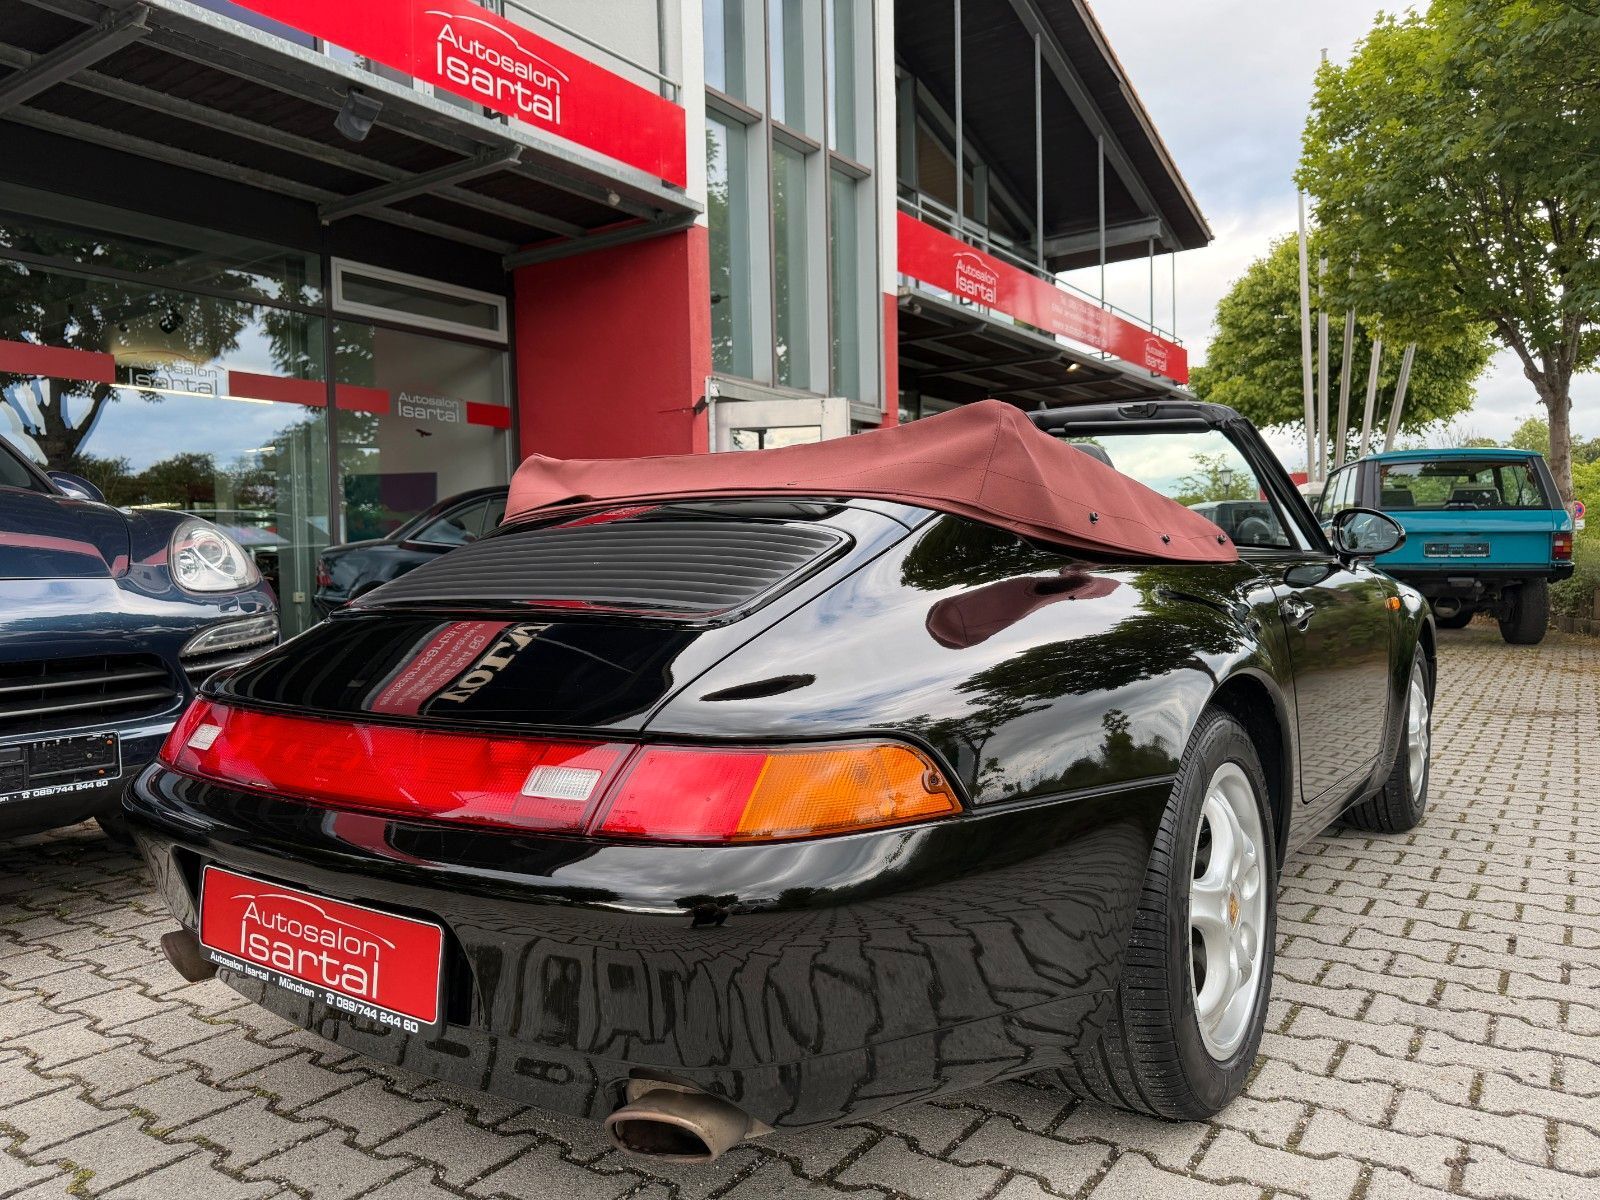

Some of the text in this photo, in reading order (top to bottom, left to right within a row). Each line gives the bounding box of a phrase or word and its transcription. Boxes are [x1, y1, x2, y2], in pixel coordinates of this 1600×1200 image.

[437, 23, 560, 94] Autosalon
[437, 42, 561, 125] Isartal
[955, 269, 996, 304] Isartal
[956, 259, 996, 286] Autosalon
[128, 368, 218, 395] Isartal
[398, 402, 460, 423] Isartal
[399, 392, 459, 408] Autosalon
[33, 780, 109, 797] 089/744 244 60
[242, 901, 380, 961] Autosalon
[240, 920, 379, 999] Isartal
[210, 950, 419, 1034] Autosalon Isartal München 089/744 244 60
